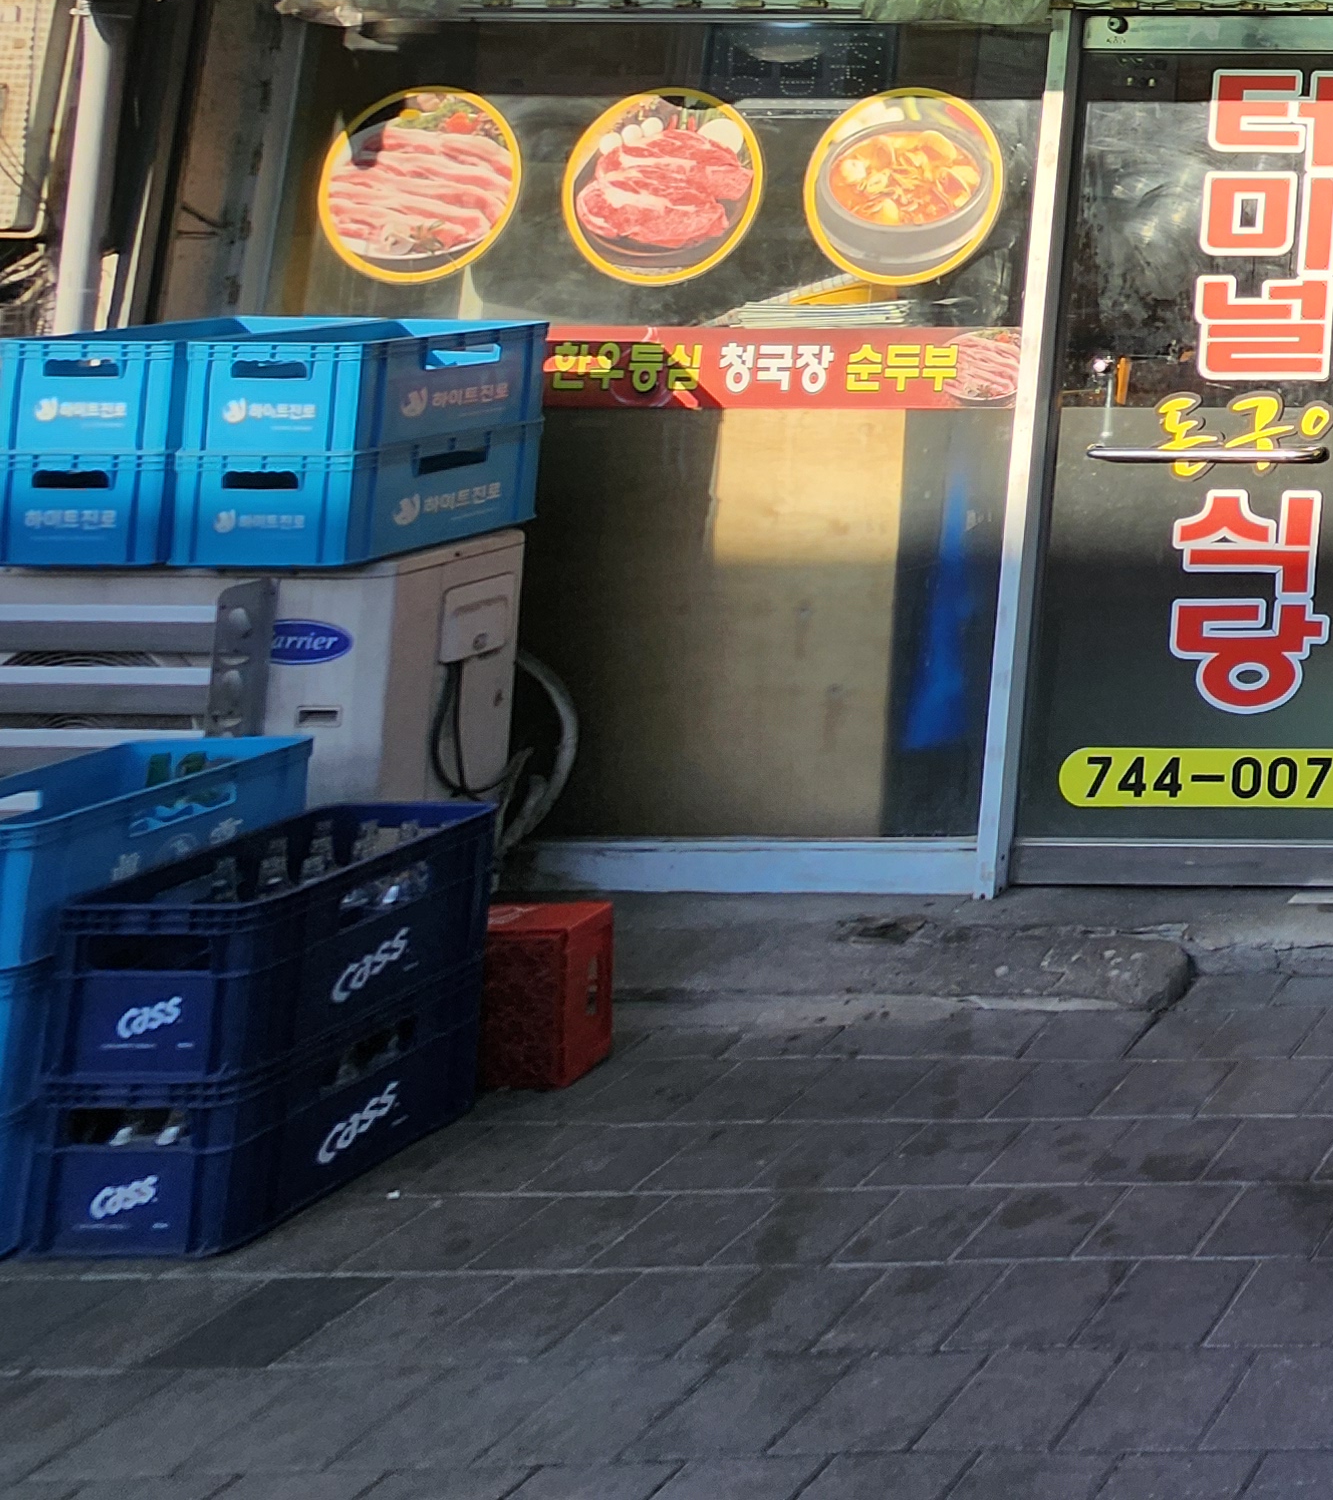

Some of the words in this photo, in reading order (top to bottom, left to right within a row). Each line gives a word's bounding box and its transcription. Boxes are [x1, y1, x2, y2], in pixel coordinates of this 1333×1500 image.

[551, 340, 703, 393] 한우등심
[718, 341, 835, 394] 청국장
[845, 342, 959, 394] 순두부
[430, 382, 511, 409] 하이트진로
[423, 481, 503, 514] 하이트진로
[1169, 489, 1331, 715] 식당
